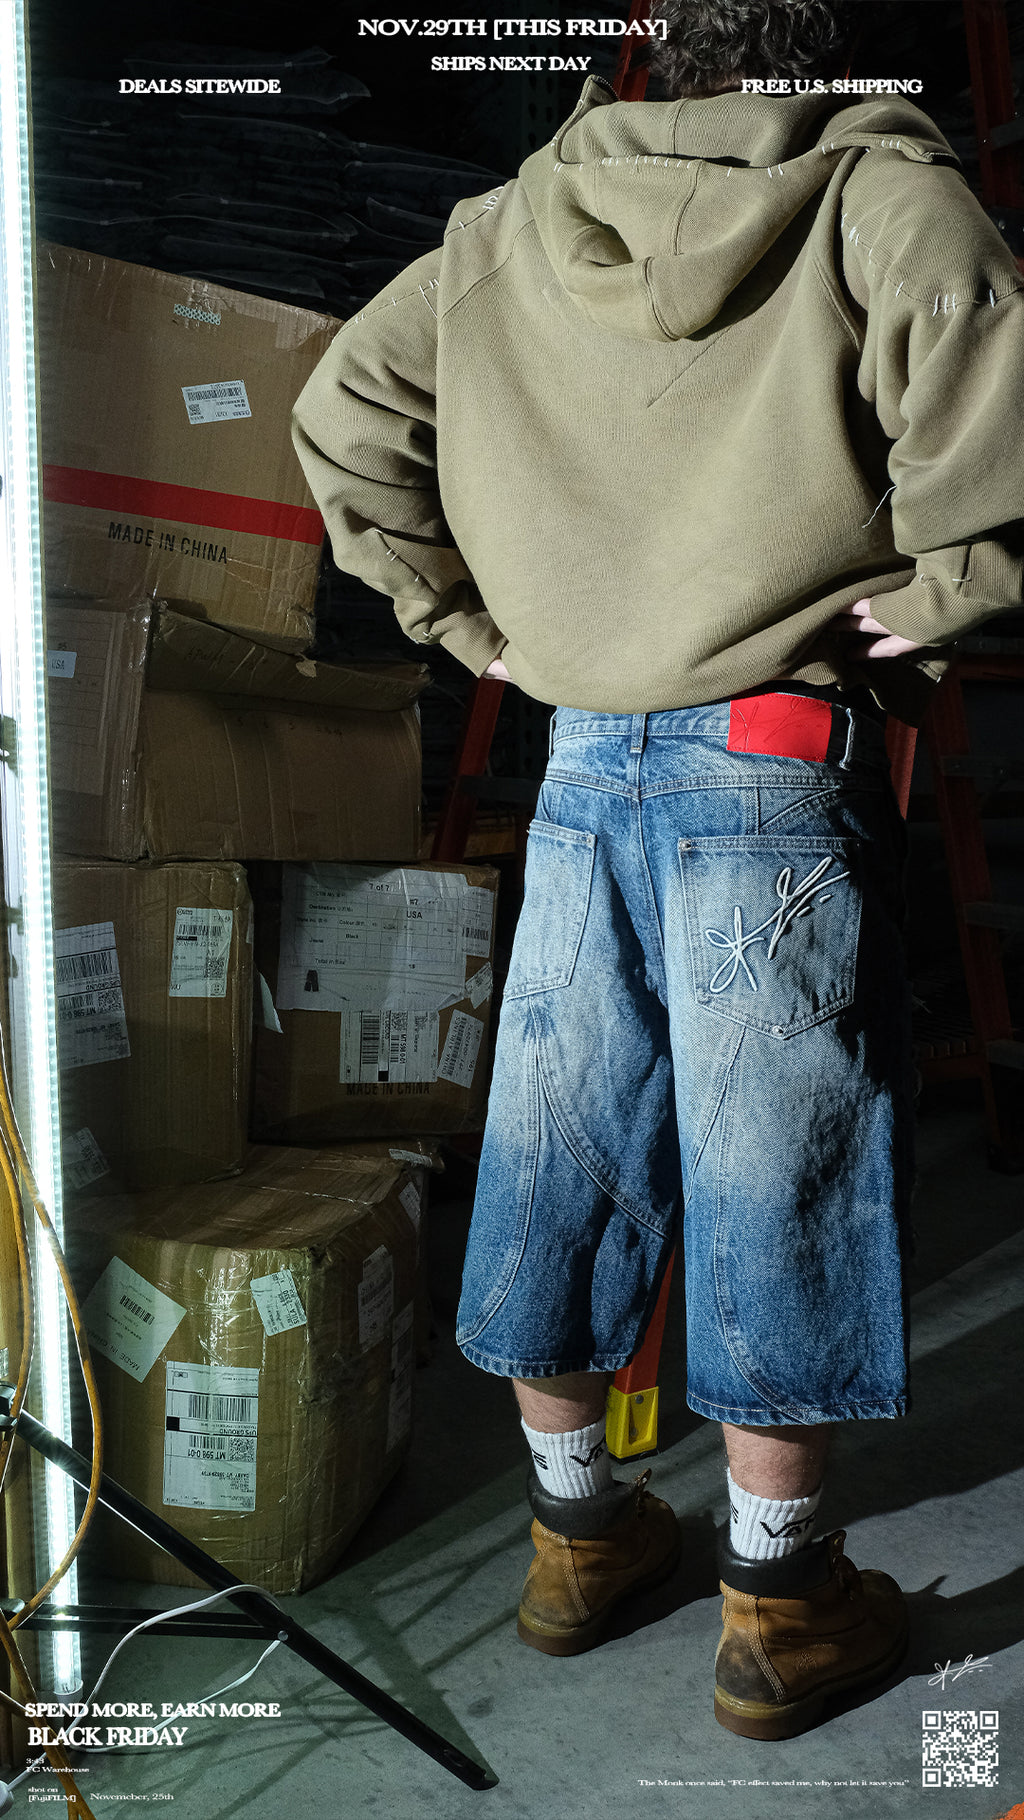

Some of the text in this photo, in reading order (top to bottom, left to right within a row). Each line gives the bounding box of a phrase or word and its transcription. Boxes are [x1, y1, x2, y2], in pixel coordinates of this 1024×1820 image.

[108, 521, 228, 564] MADE IN CHINA
[375, 884, 384, 892] of
[406, 910, 423, 919] USA
[86, 1007, 96, 1016] MT
[442, 1016, 461, 1075] CHINA AIRLINES
[120, 1352, 140, 1371] MADE
[187, 1449, 226, 1460] MT 598 0-01
